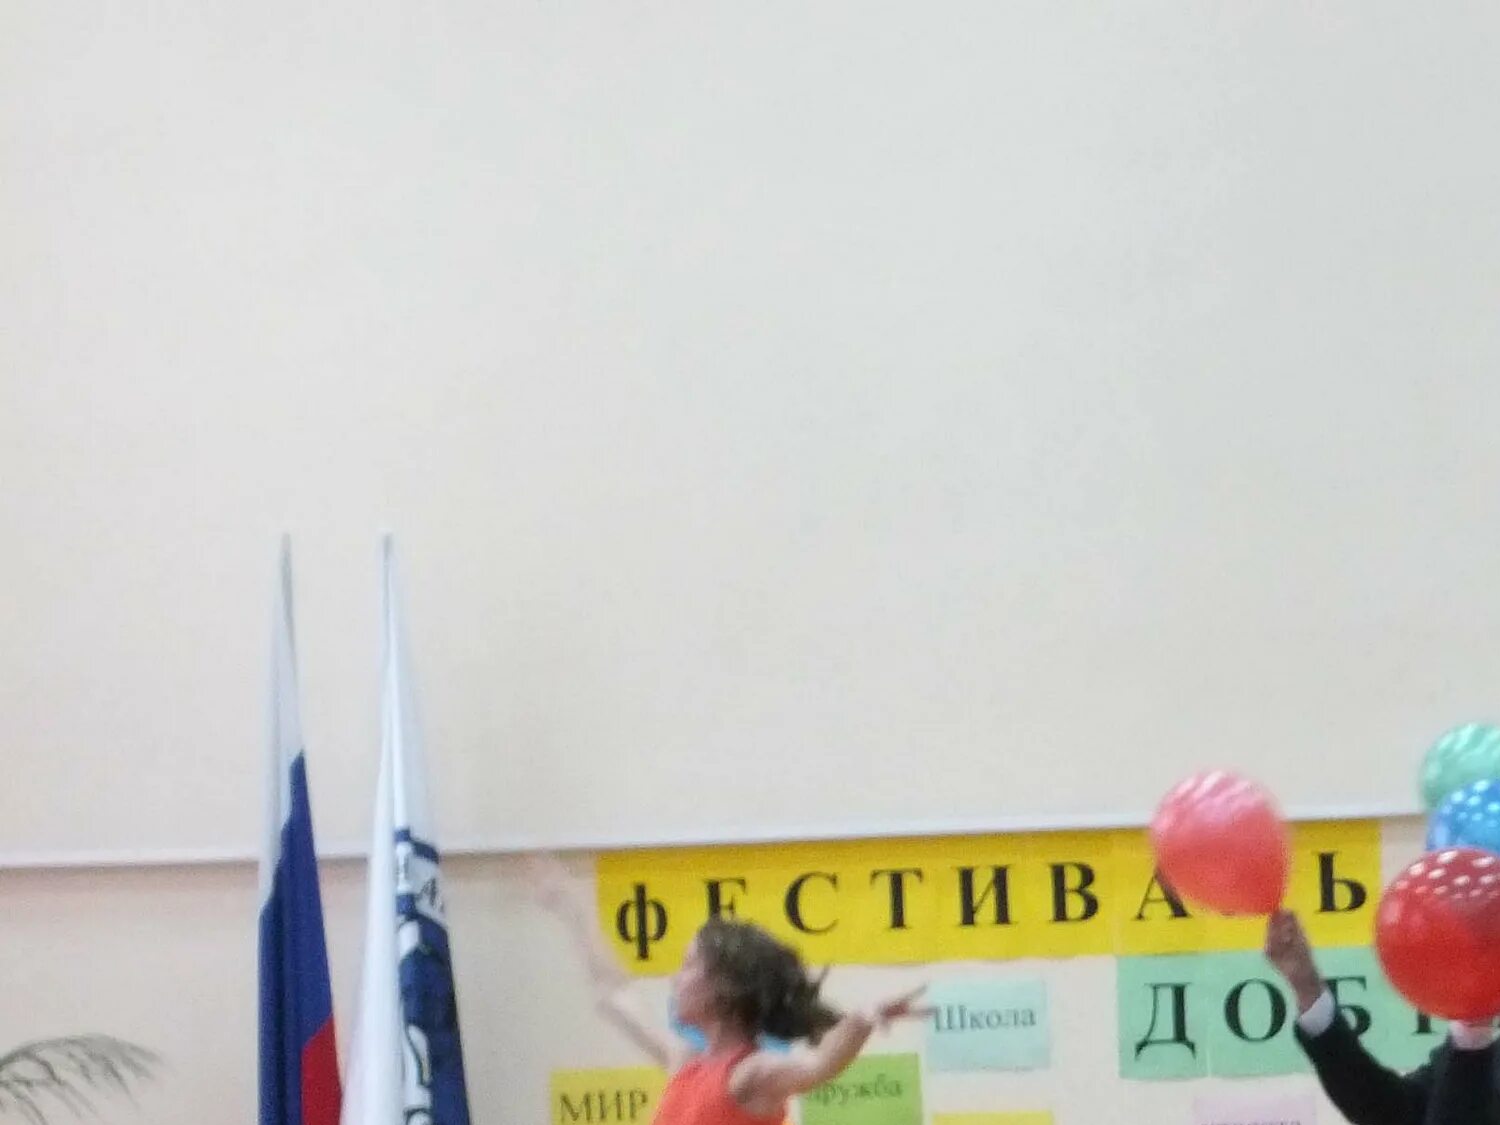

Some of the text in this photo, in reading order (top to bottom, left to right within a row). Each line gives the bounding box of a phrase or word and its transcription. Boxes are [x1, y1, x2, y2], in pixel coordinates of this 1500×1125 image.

[615, 851, 1368, 960] фЕСТИВАЬ
[934, 1003, 1038, 1031] Школа
[560, 1089, 649, 1123] МИР
